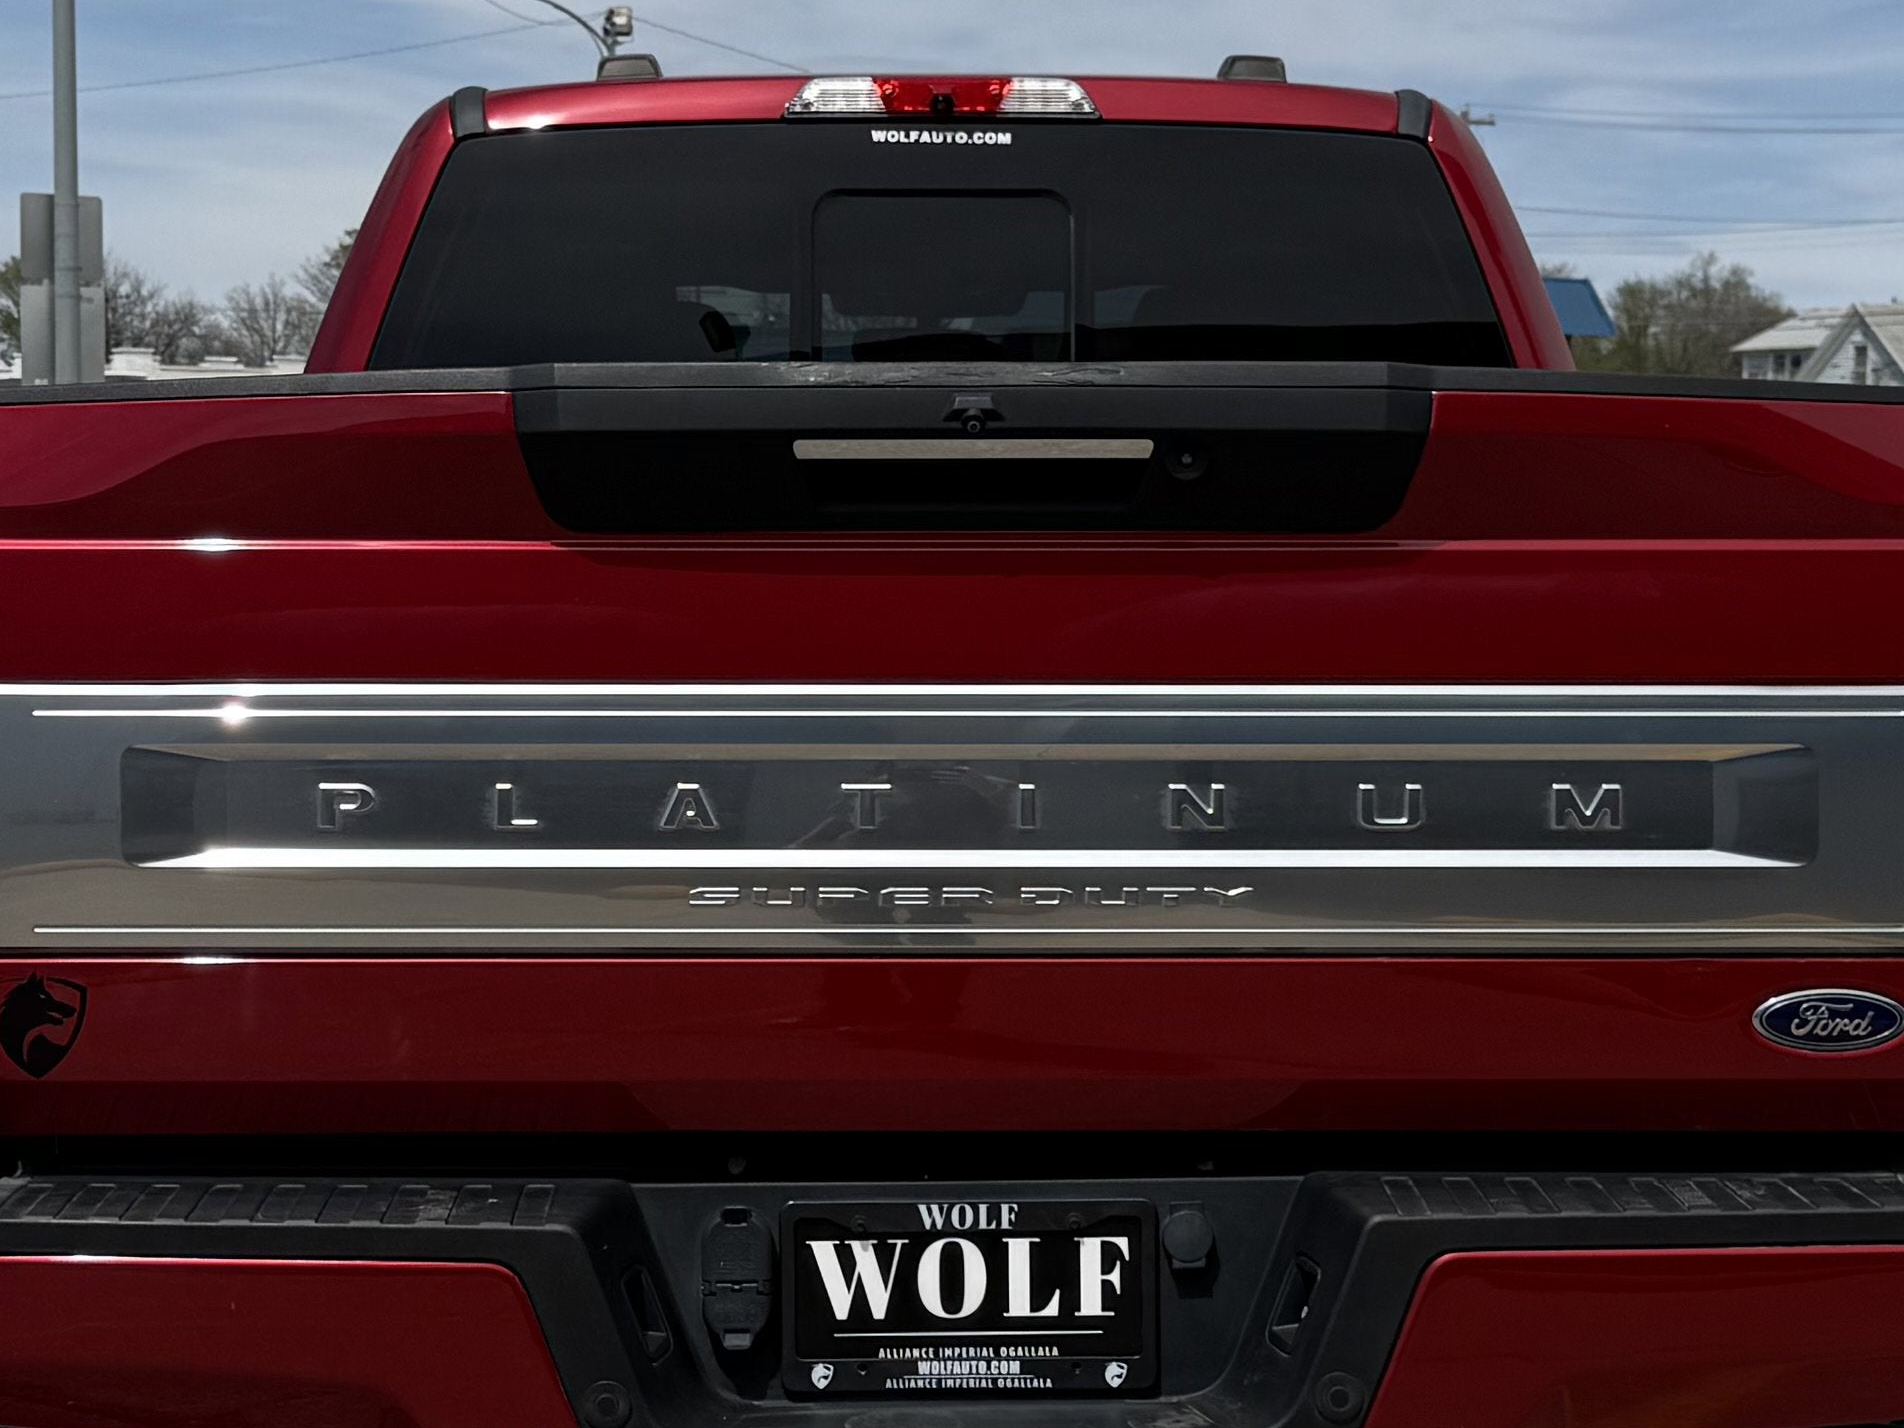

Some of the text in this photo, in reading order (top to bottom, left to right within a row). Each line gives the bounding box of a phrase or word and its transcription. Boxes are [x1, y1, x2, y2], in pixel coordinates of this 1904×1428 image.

[871, 130, 1012, 145] WOLFAUTO.COM
[313, 782, 1624, 830] PLATINUM
[688, 886, 1254, 906] SUPER DUTY
[1790, 1002, 1875, 1036] Ford
[917, 1203, 1019, 1230] WOLF
[806, 1237, 1131, 1321] WOLF
[878, 1346, 1059, 1359] ALLIANCE IMPERIAL OGALLALA
[917, 1360, 1021, 1375] WOLFAUTO.COM
[885, 1378, 1053, 1389] ALLIANCE IMPERIAL OGALLALA
